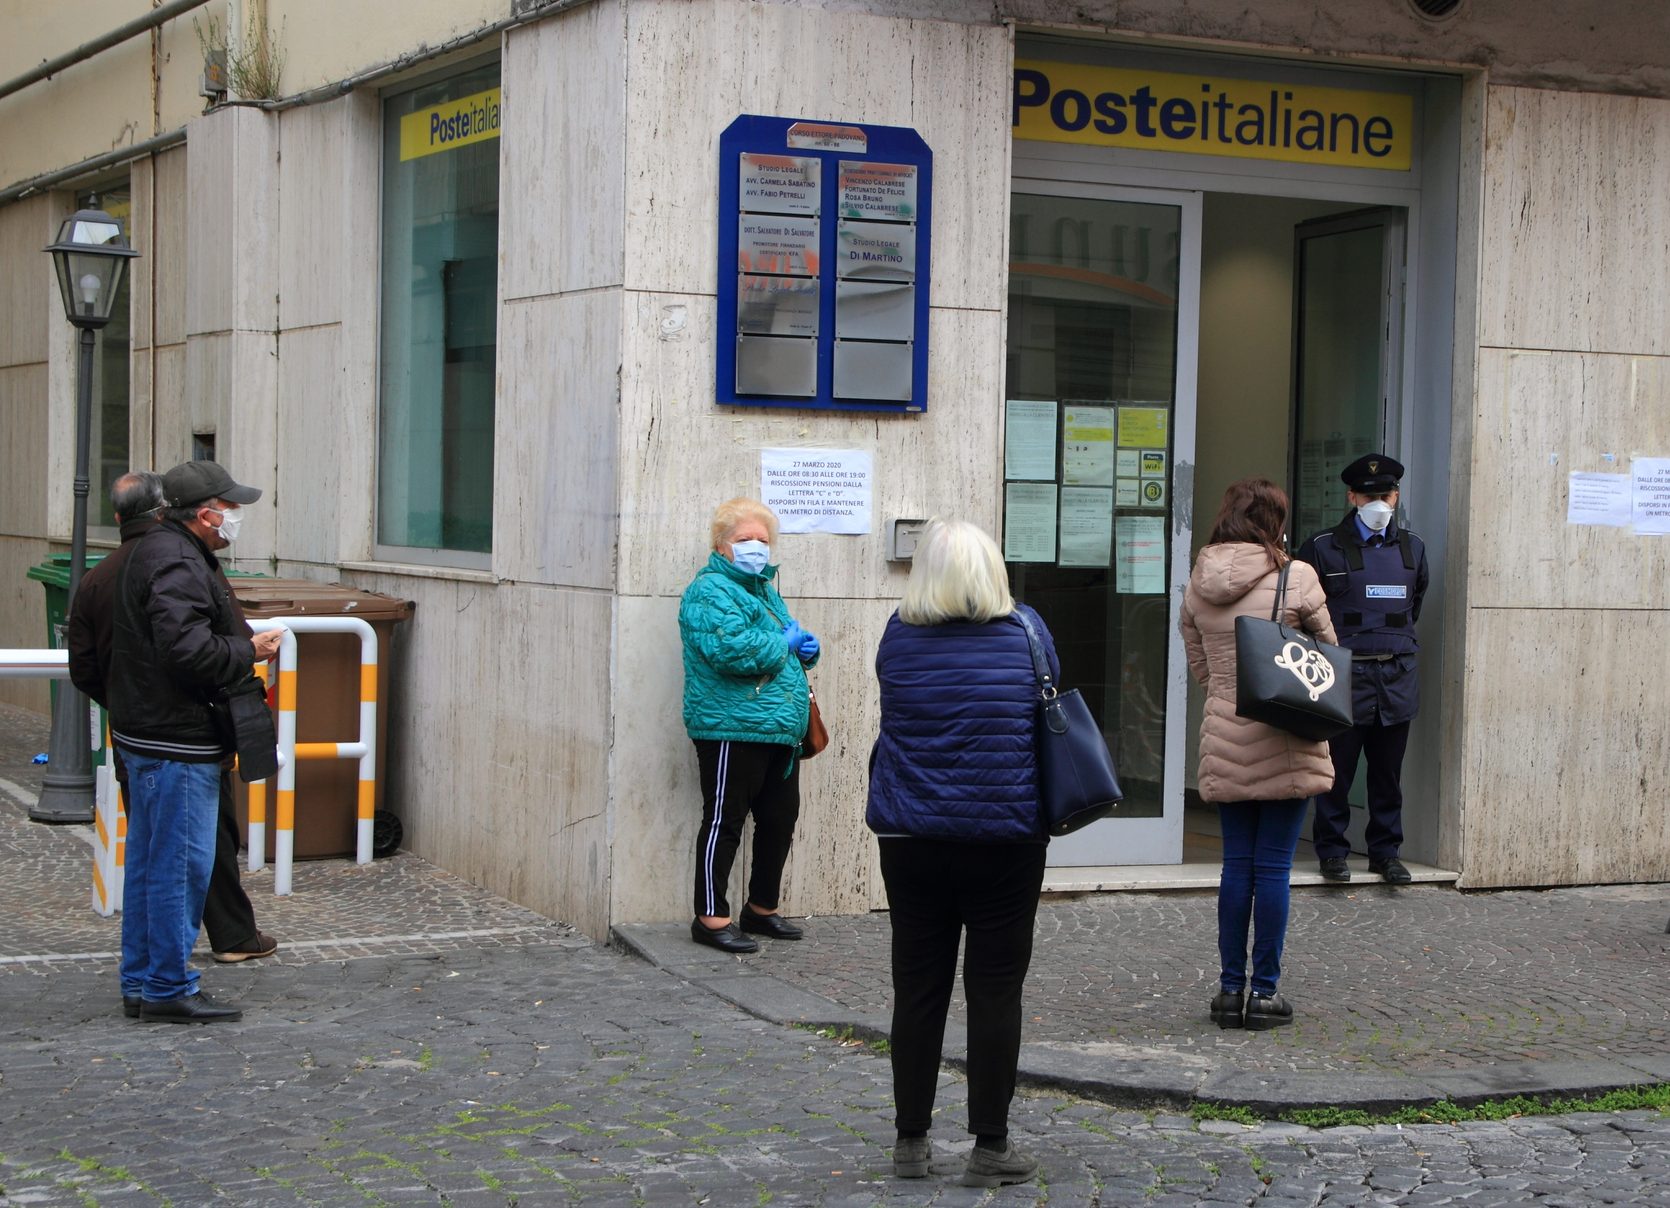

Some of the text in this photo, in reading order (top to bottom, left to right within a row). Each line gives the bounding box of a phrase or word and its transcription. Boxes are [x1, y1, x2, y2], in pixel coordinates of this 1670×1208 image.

[1012, 68, 1393, 157] Posteitaliane
[430, 96, 501, 145] Posteitalia
[758, 164, 803, 174] STUDIO LEGALE
[746, 177, 815, 188] AVV. CARMELA SABATINO
[845, 177, 905, 187] VINCENZO CALABRESE
[760, 190, 777, 198] FABIO
[779, 190, 805, 199] PETRELLI
[845, 185, 876, 194] FORTUNATO
[887, 188, 905, 196] FELICE
[845, 193, 861, 201] ROSA
[845, 201, 898, 212] SILVIO CALABRESE
[877, 240, 899, 248] LEGALE
[850, 251, 903, 263] DI MARTINO
